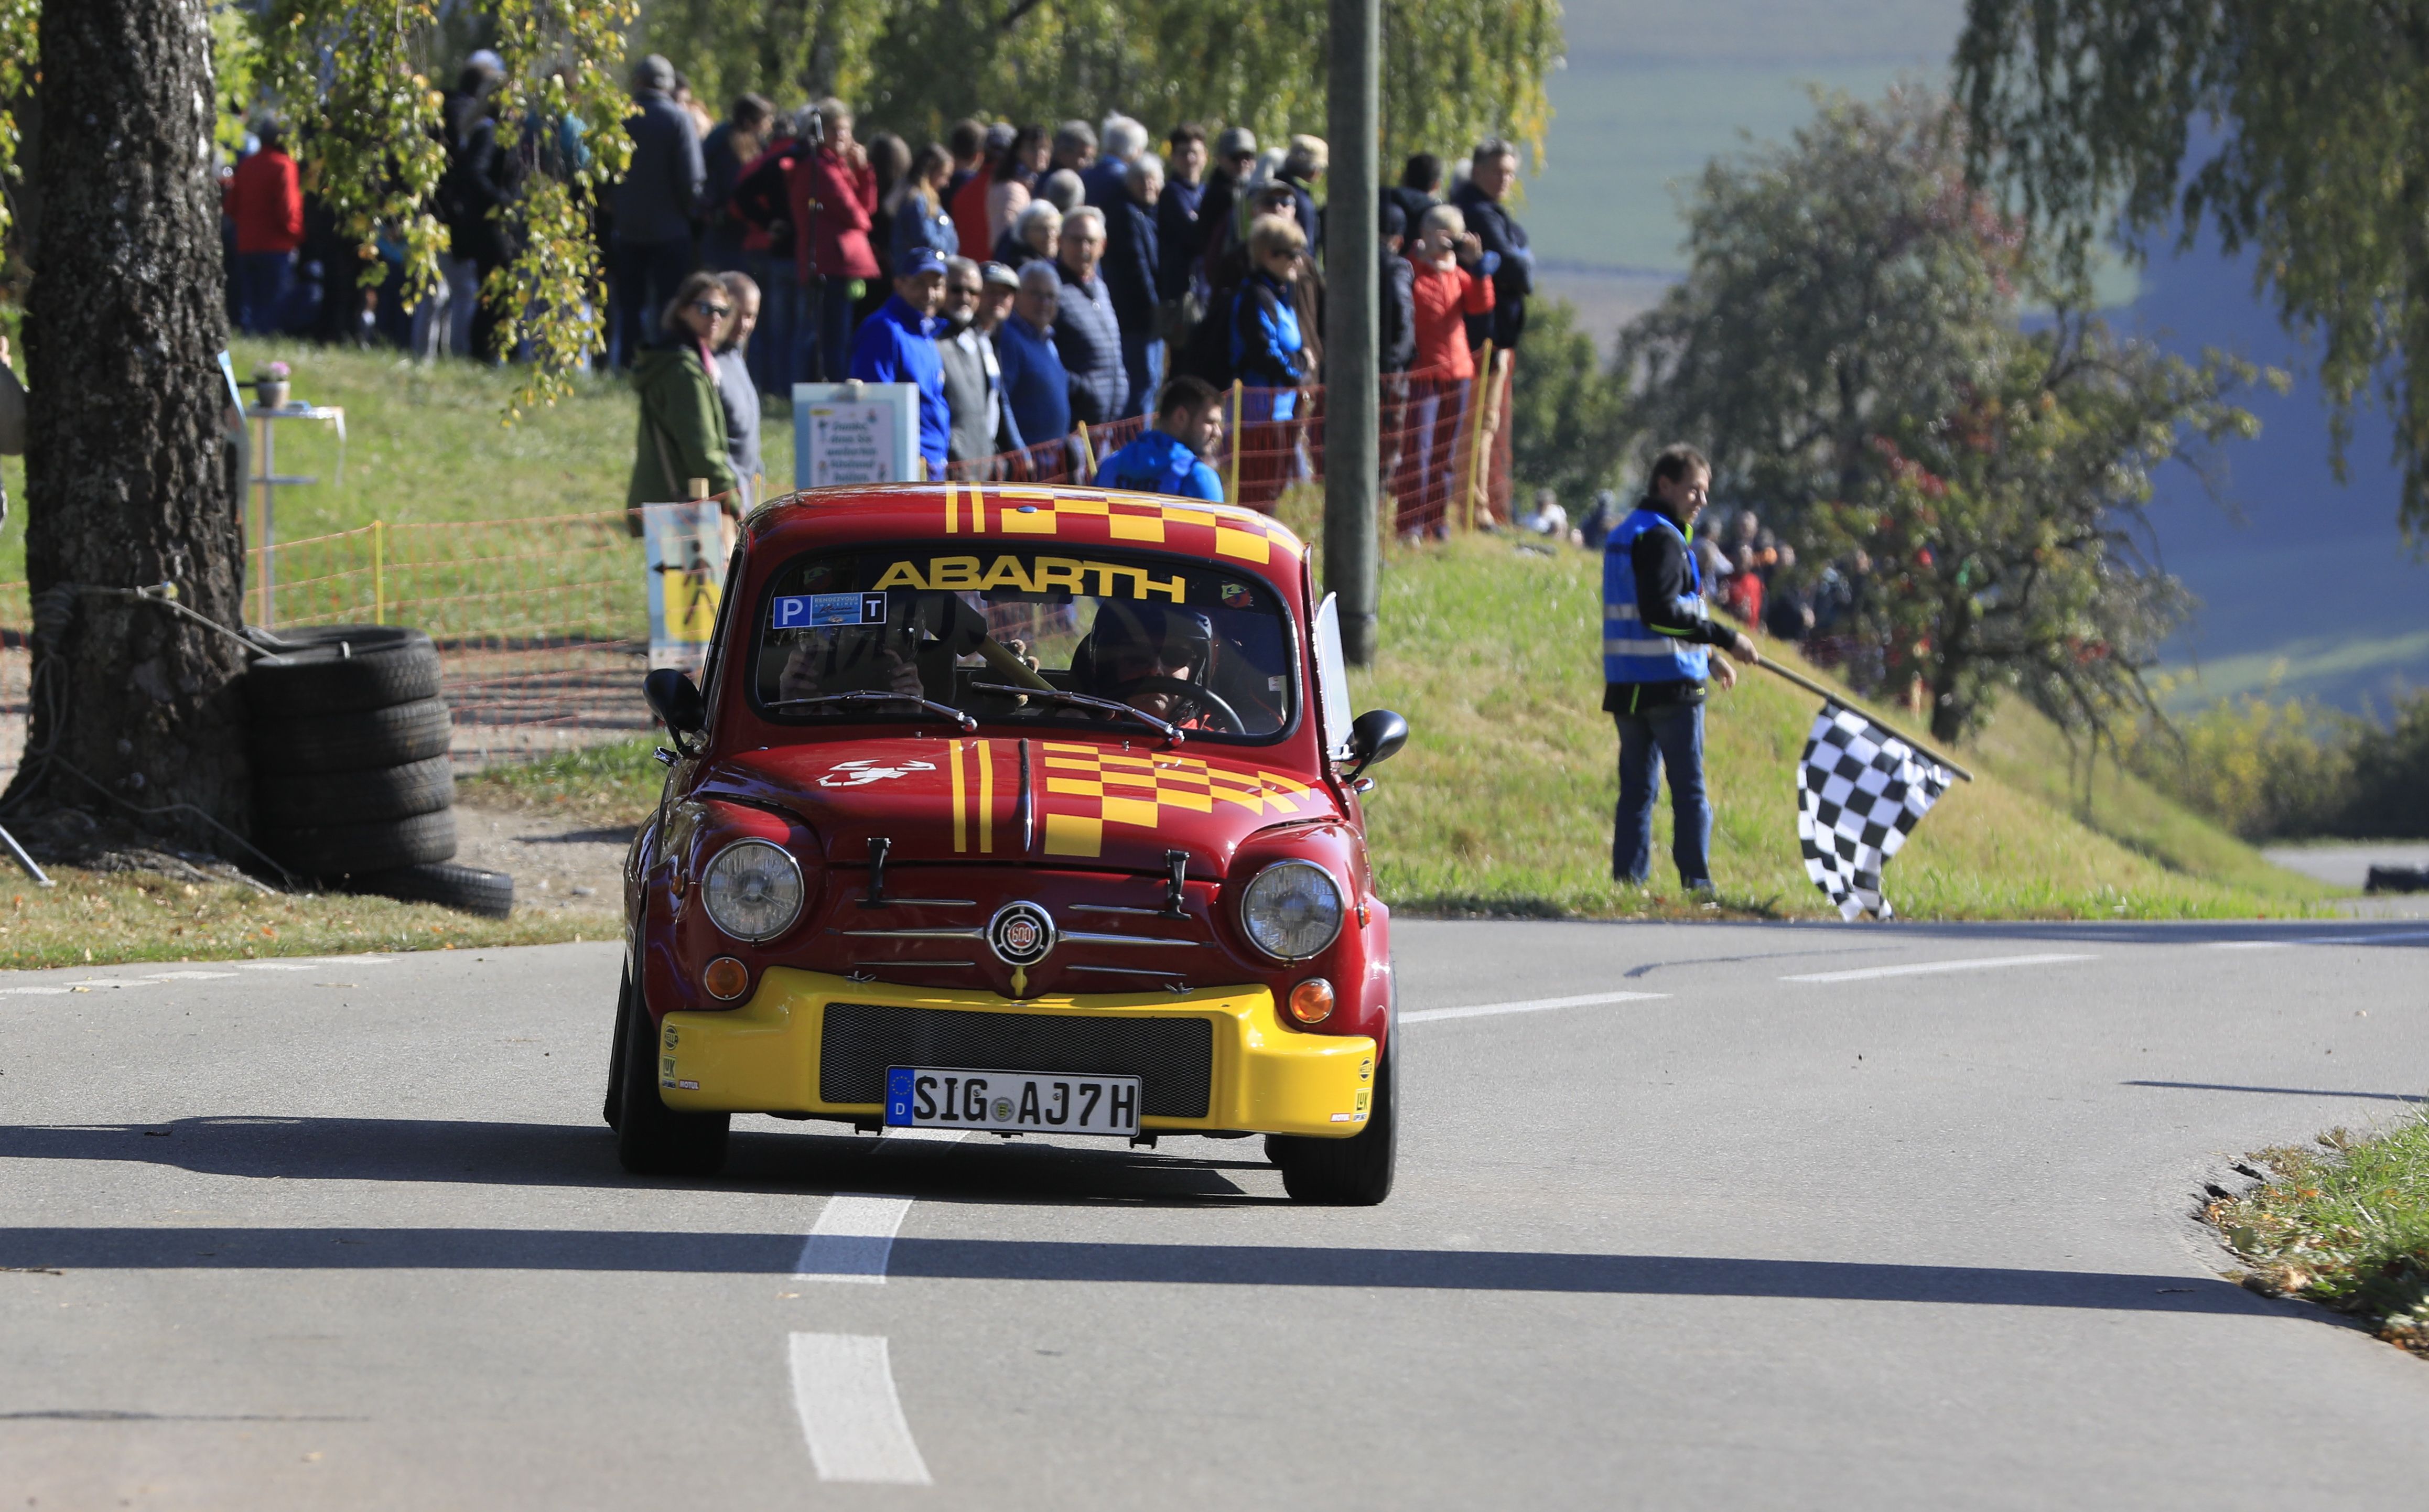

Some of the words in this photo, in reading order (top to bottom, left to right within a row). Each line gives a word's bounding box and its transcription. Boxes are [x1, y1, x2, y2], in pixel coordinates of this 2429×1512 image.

[872, 555, 1185, 603] ABARTH
[782, 598, 804, 625] P
[866, 600, 881, 617] T
[1012, 926, 1031, 943] 600
[679, 1081, 699, 1089] MOTUL
[895, 1102, 905, 1115] D
[913, 1076, 988, 1121] SIG
